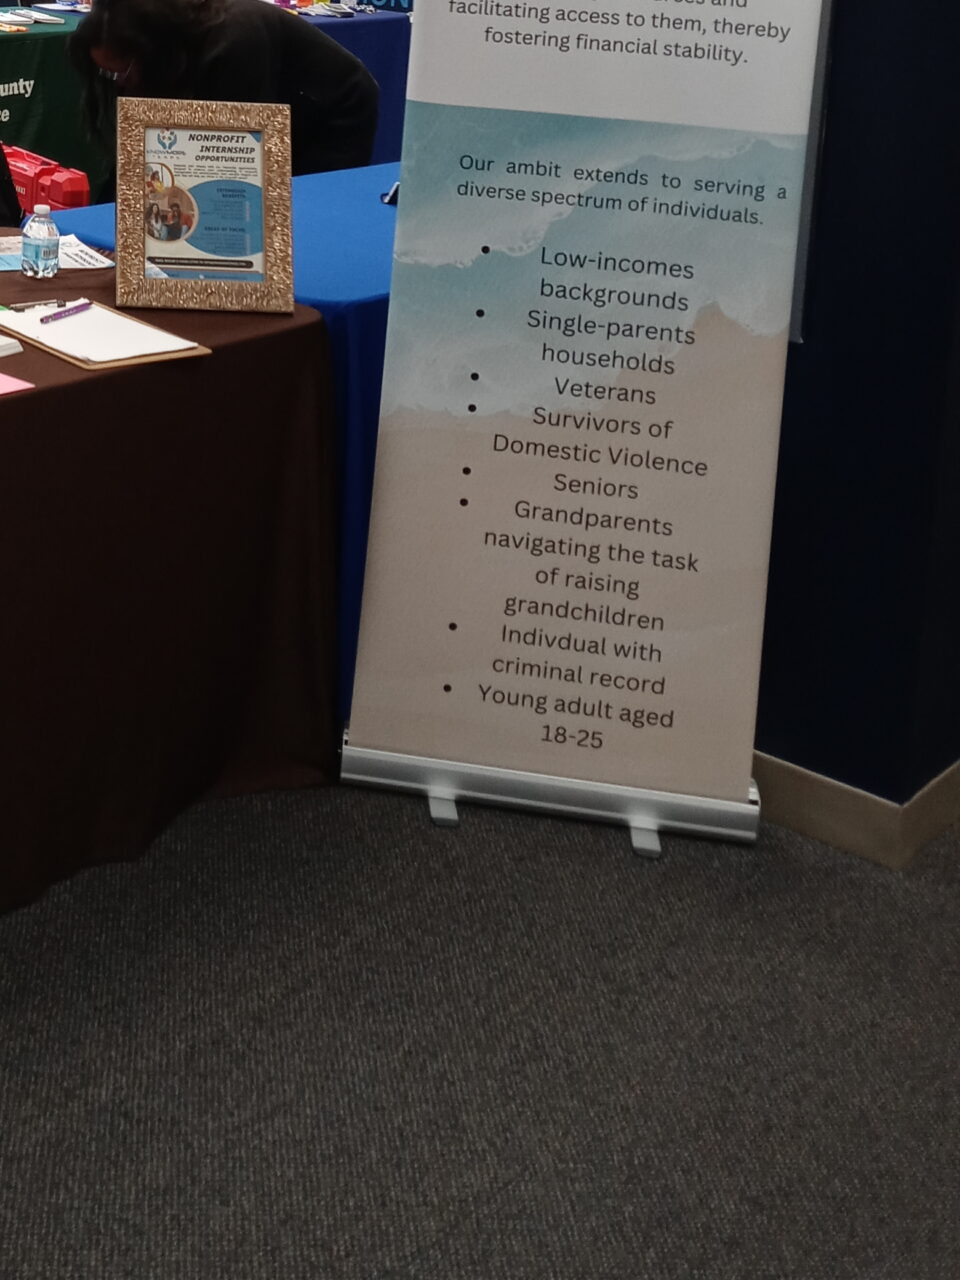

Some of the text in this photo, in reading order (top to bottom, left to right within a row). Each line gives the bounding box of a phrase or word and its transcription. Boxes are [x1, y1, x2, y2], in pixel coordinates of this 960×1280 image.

[555, 8, 621, 26] access
[625, 11, 646, 27] to
[651, 12, 707, 36] them,
[713, 17, 791, 43] thereby
[484, 26, 748, 67] fostering financial stability.
[188, 133, 247, 144] NONPROFIT
[200, 145, 256, 155] INTERNSHIP
[195, 154, 256, 164] OPPORTUNITIES
[459, 154, 787, 203] Our ambit extends to serving a
[456, 180, 764, 225] diverse spectrum of individuals.
[540, 245, 694, 280] Low-incomes
[540, 277, 689, 312] backgrounds
[527, 309, 696, 345] Single-parents
[541, 342, 675, 375] households
[554, 376, 656, 405] Veterans
[532, 406, 674, 439] Survivors of
[493, 433, 708, 477] Domestic Violence
[553, 473, 639, 500] Seniors
[514, 499, 673, 537] Grandparents
[484, 531, 699, 573] navigating the task
[535, 566, 640, 601] of raising
[503, 596, 664, 631] grandchildren
[502, 624, 662, 663] Indivdual with
[492, 656, 666, 696] criminal record
[478, 683, 675, 729] Young adult aged
[541, 724, 603, 750] 18-25
